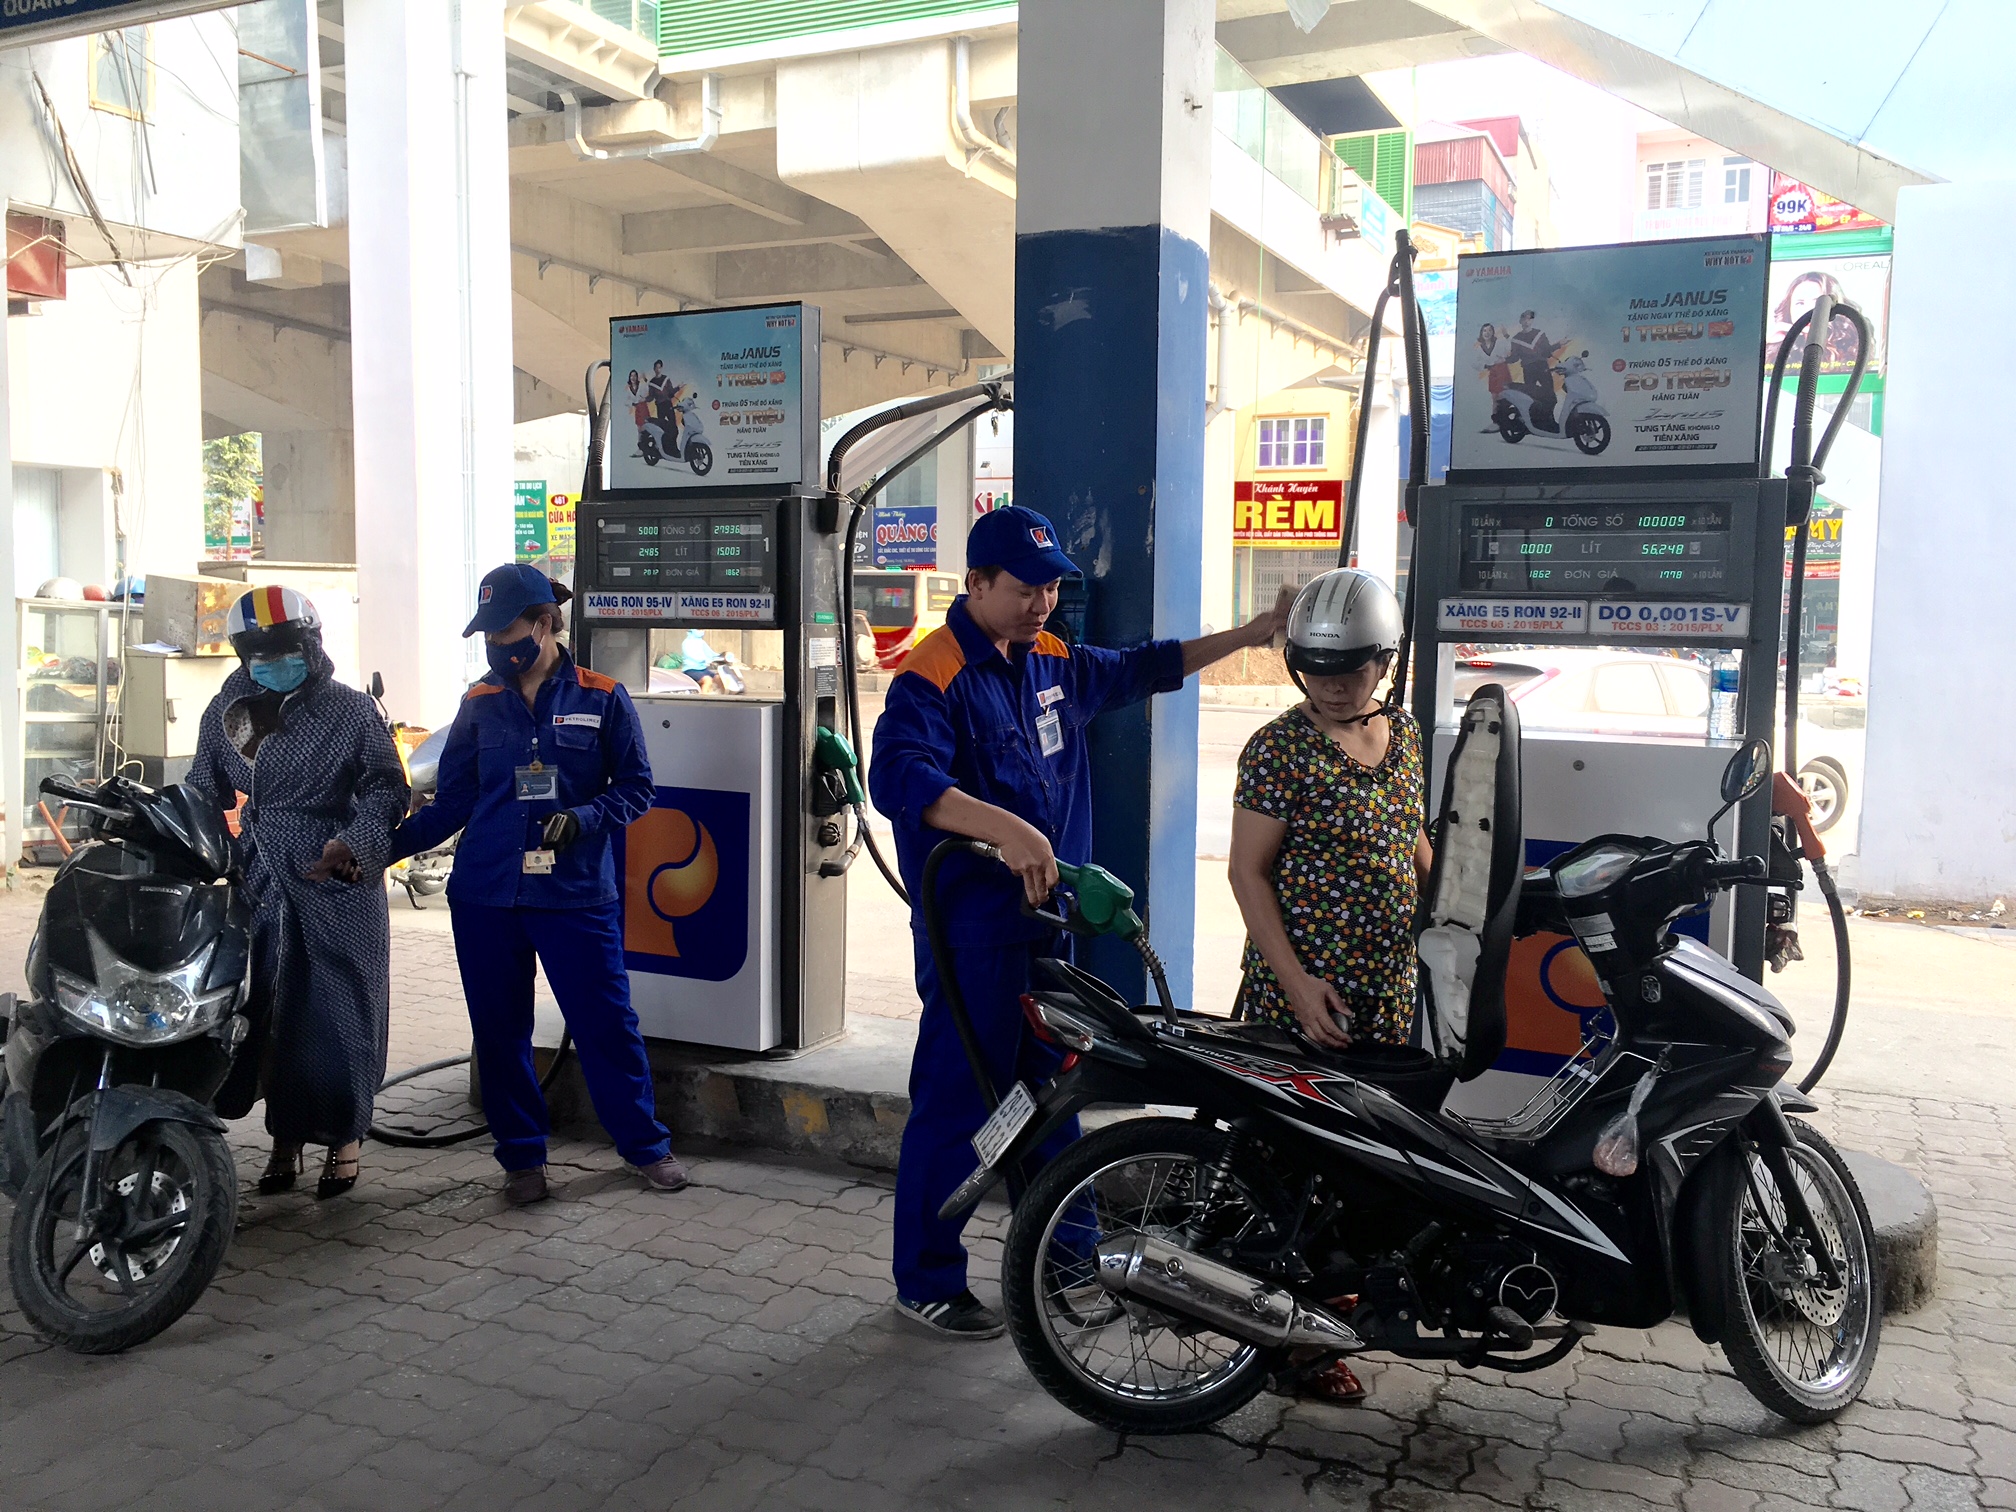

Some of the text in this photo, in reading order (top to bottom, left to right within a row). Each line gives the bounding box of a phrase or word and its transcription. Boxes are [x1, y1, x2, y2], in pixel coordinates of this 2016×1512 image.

[1776, 199, 1808, 214] 99K
[1475, 265, 1512, 277] YAMAHA
[1629, 289, 1728, 309] Mua JANUS
[1627, 312, 1649, 322] TẶNG
[1650, 311, 1672, 320] NGAY
[1705, 308, 1729, 317] XĂNG
[626, 324, 648, 333] YAMAHA
[1621, 319, 1704, 343] 1 TRIỆU
[721, 346, 781, 361] Mua JANUS
[1629, 360, 1656, 369] TRÚNG
[1657, 358, 1671, 367] 05
[1704, 357, 1728, 366] XĂNG
[716, 370, 768, 388] 1 TRIỆU
[1623, 367, 1732, 391] 20 TRIỆU
[1652, 391, 1700, 401] HÀNG TUẦN
[740, 399, 748, 407] 05
[719, 407, 785, 426] 20 TRIỆU
[1634, 425, 1659, 433] TUNG
[1674, 432, 1700, 441] XĂNG
[1254, 483, 1285, 493] Khánh
[549, 508, 564, 523] CỬA
[1235, 494, 1336, 529] RÈM
[1545, 516, 1554, 528] 0
[1561, 513, 1624, 527] TỔNG SỐ
[1638, 516, 1685, 527] 100009
[638, 526, 659, 535] 5000
[662, 524, 702, 535] TỔNG SỐ
[713, 525, 740, 535] 27936
[876, 518, 928, 546] QUẢNG
[763, 537, 769, 552] 1
[1581, 541, 1602, 553] LÍT
[675, 546, 688, 556] LÍT
[666, 566, 700, 577] ĐƠN GIÁ
[1529, 570, 1551, 579] 1862
[1564, 568, 1619, 579] ĐƠN GIÁ
[1659, 570, 1683, 579] 1778
[588, 595, 673, 608] XĂNG RON 95-IV
[681, 595, 771, 609] XĂNG E5 RON 92-II
[598, 608, 616, 617] TCCS
[631, 608, 663, 617] 2015/PLX
[691, 609, 710, 617] TCCS
[727, 610, 760, 618] 2015/PLX
[1445, 603, 1581, 619] XĂNG E5 RON 92-II
[1599, 606, 1740, 622] DO 0,001S-V
[1460, 619, 1488, 629] TCCS
[1491, 620, 1504, 629] 06
[1513, 620, 1564, 630] 2015/PLX
[1611, 622, 1642, 631] TCCS
[1645, 622, 1659, 632] 03
[1669, 623, 1724, 632] 2015/PLX
[999, 1089, 1032, 1133] 29-L1
[976, 1116, 1009, 1165] 113.34
